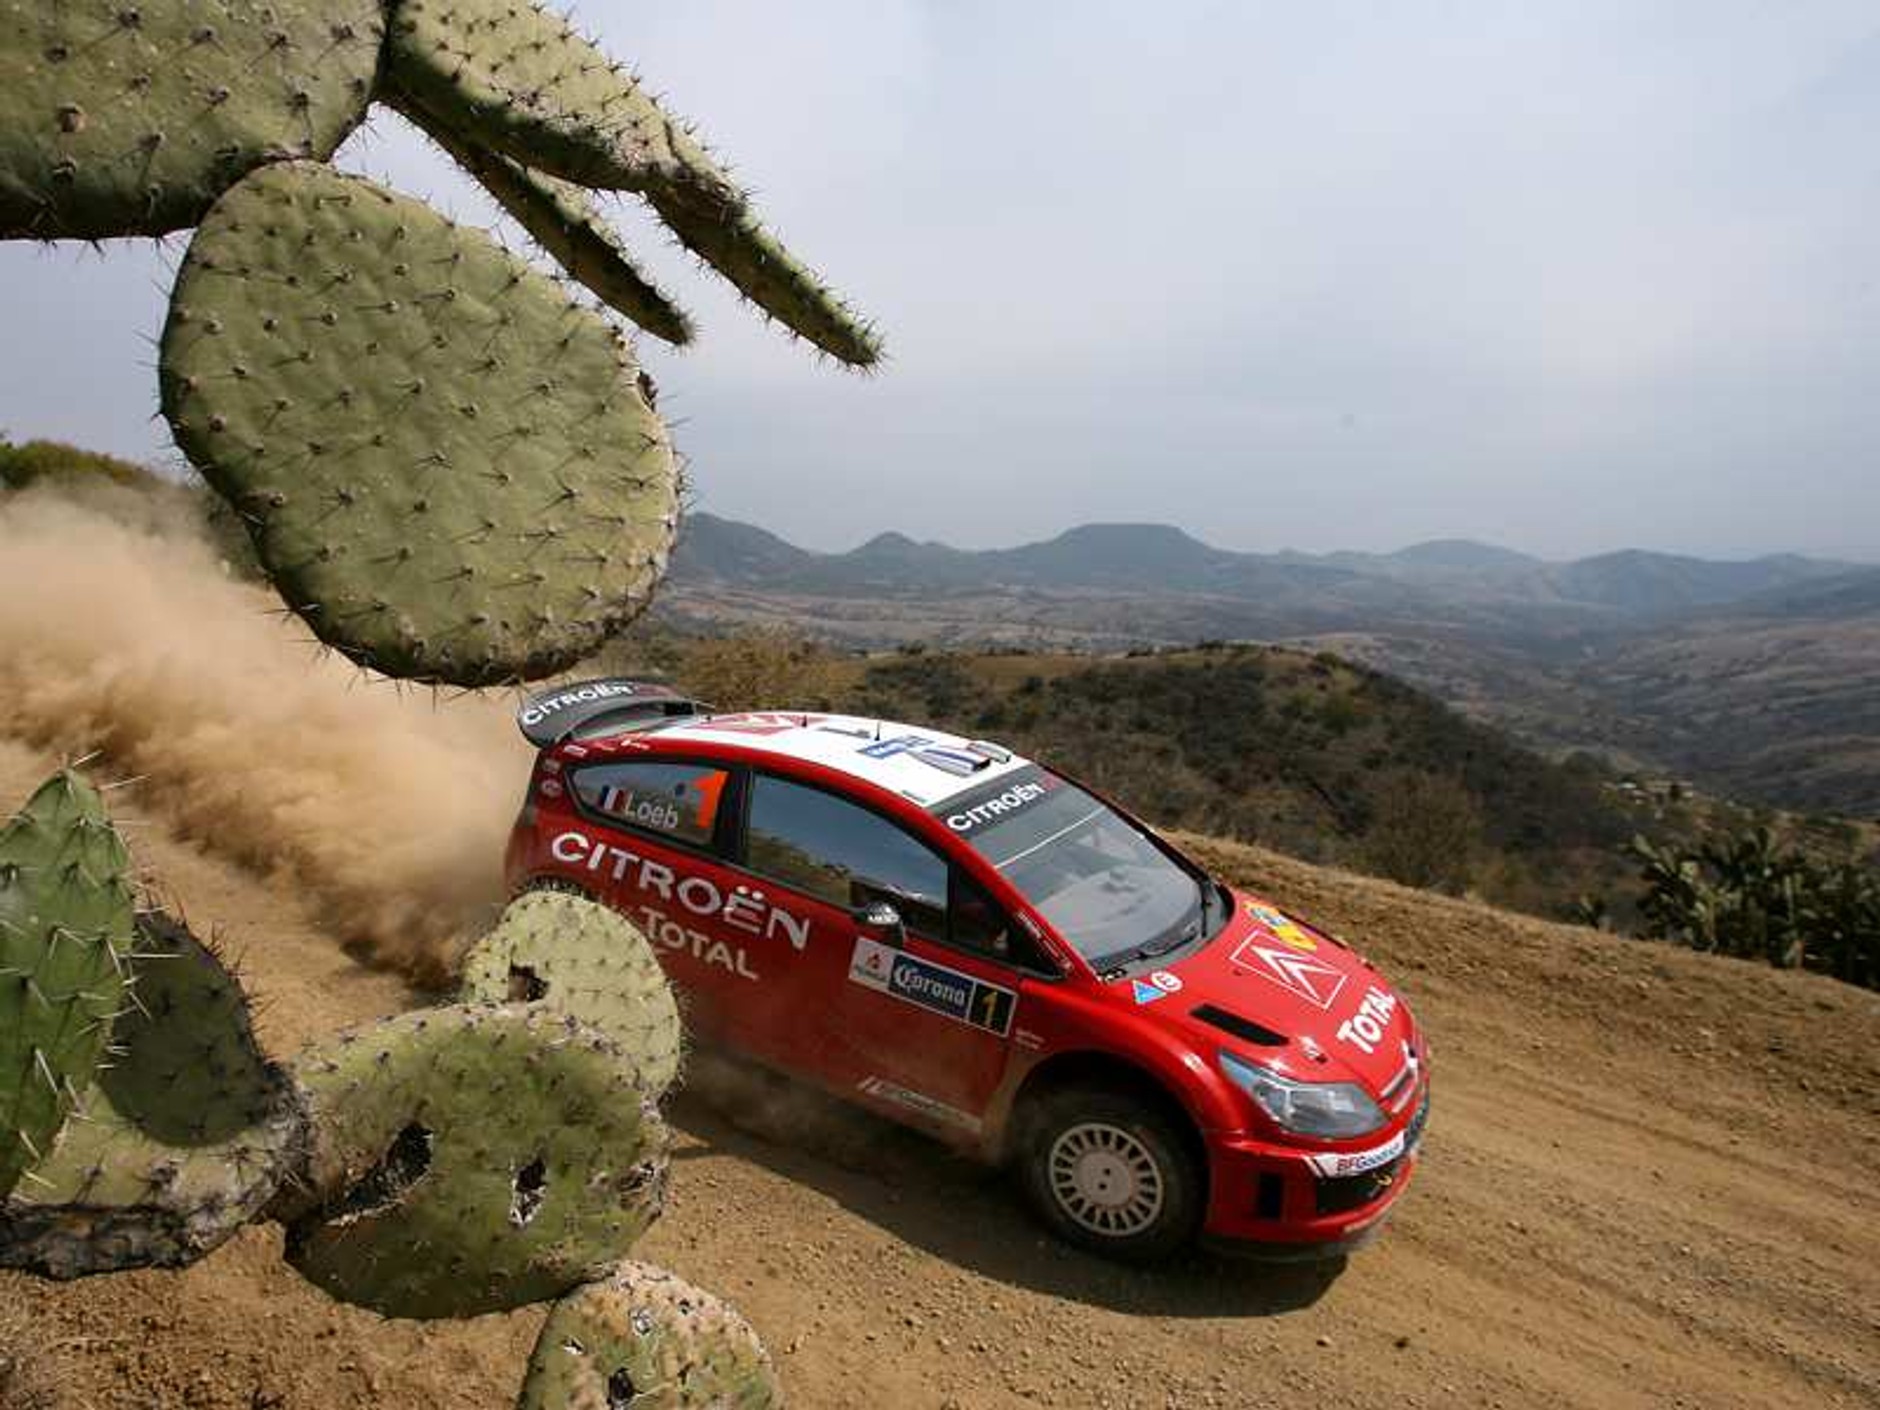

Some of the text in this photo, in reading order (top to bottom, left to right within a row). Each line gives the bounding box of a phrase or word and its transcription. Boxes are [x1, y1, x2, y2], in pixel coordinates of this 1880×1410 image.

[523, 682, 633, 724] CITROËN
[624, 793, 679, 829] Loeb
[693, 769, 730, 828] 1
[947, 784, 1046, 832] CITROËN
[552, 832, 810, 950] CITROËN
[640, 906, 759, 981] TOTAL
[894, 963, 967, 1006] Corona
[982, 989, 998, 1027] 1
[1336, 986, 1396, 1054] TOTAL
